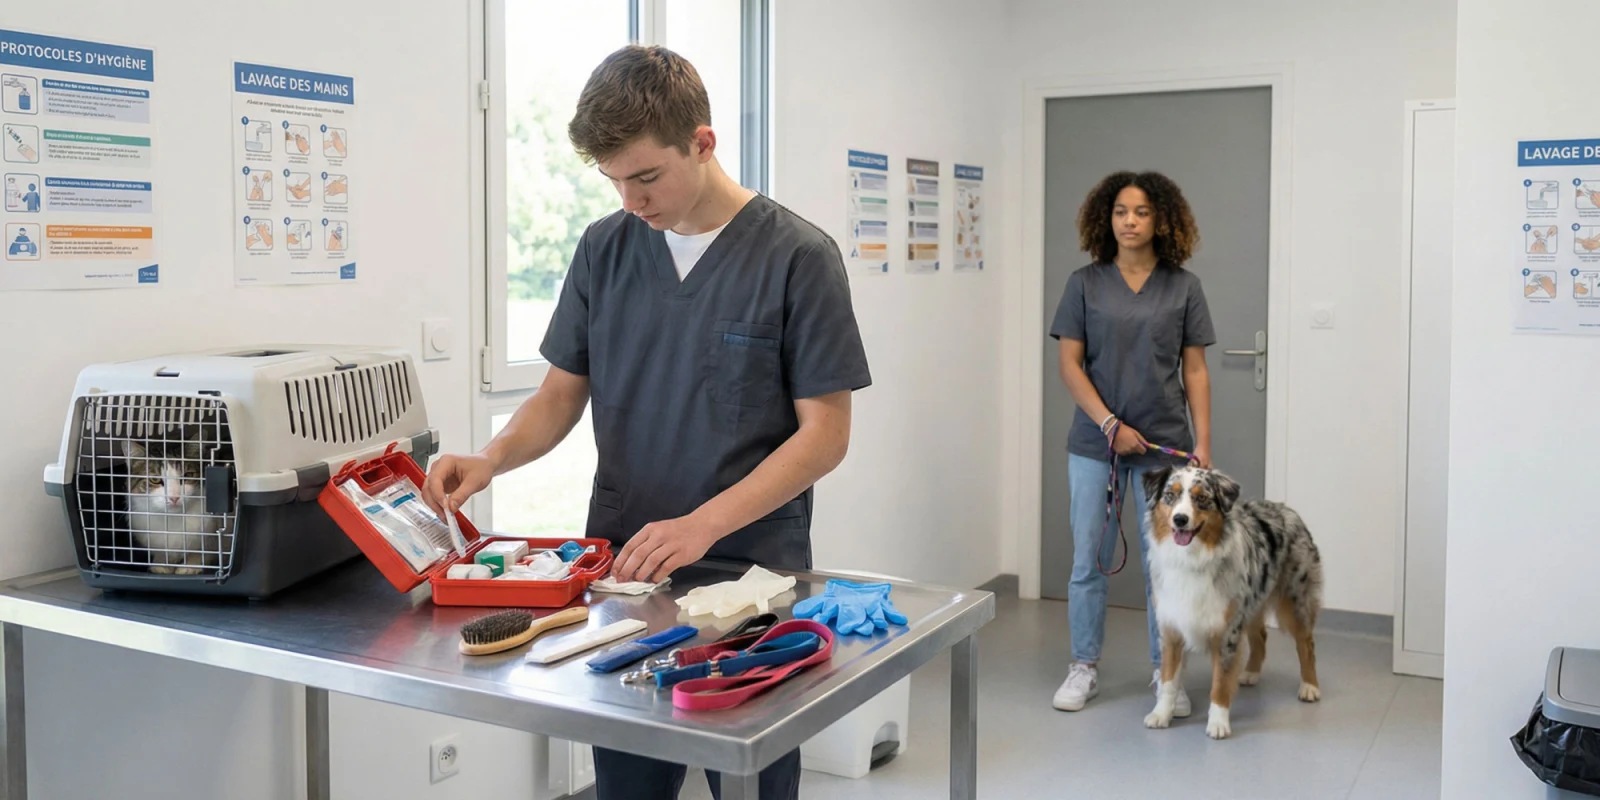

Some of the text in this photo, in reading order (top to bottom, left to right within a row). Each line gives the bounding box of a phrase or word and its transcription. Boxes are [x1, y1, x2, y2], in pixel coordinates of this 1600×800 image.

[0, 41, 147, 71] PROTOCOLES D'HYGIÈNE
[240, 71, 349, 97] LAVAGE DES MAINS
[1524, 146, 1580, 160] LAVAGE
